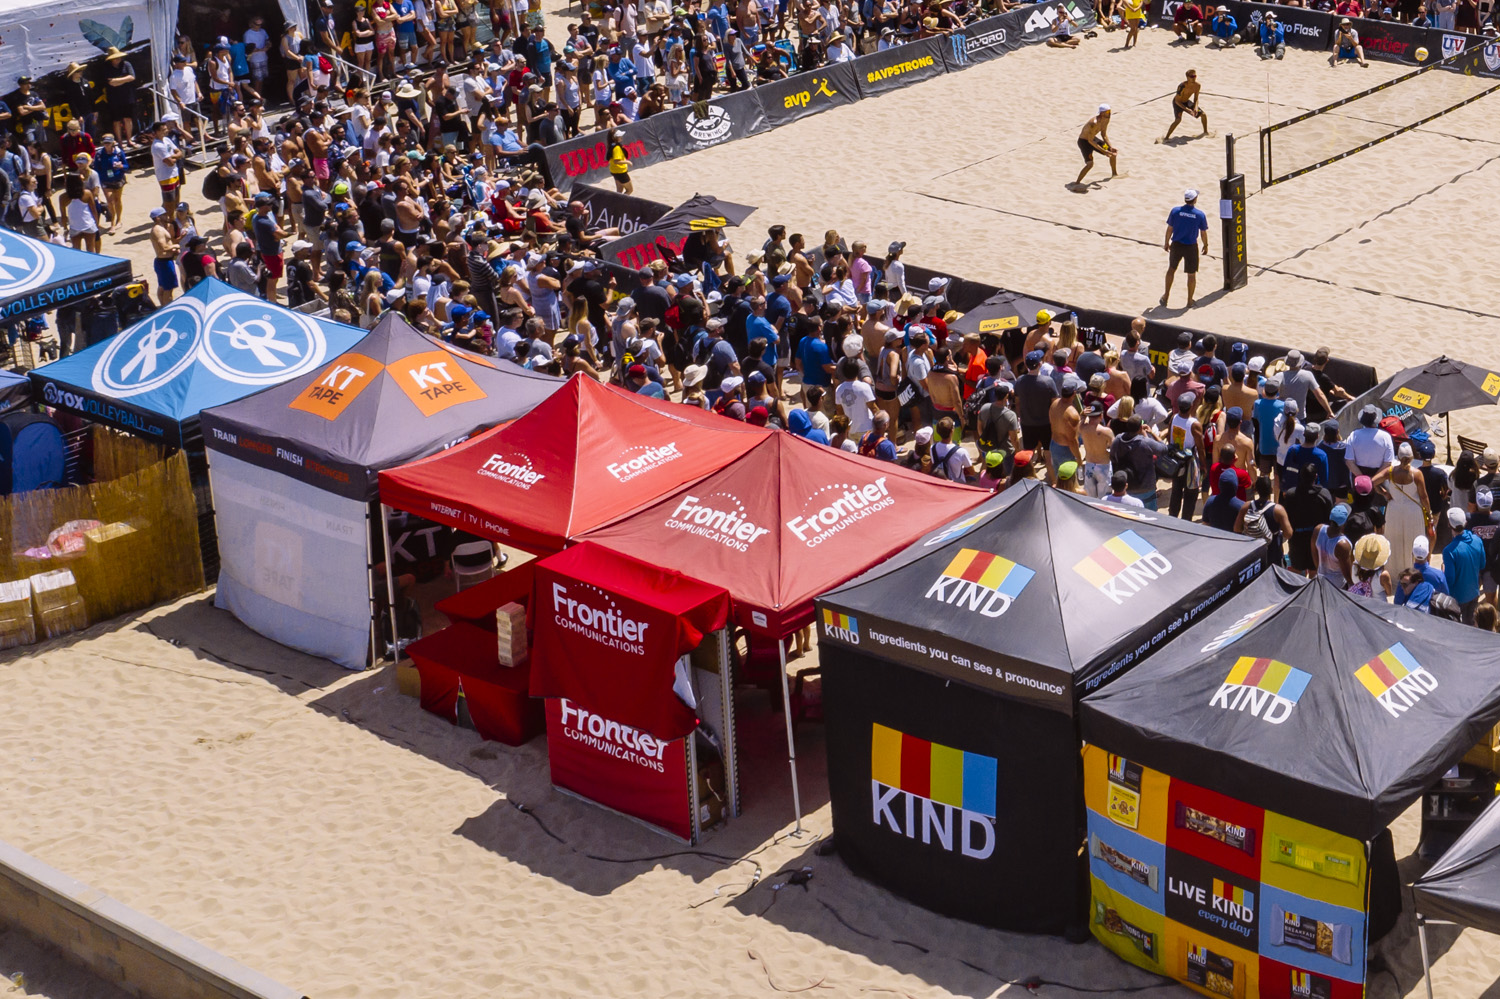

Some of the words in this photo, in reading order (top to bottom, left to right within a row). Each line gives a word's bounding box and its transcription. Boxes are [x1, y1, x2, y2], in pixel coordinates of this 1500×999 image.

[967, 30, 1003, 48] HYDRO
[1293, 23, 1320, 37] Flask
[1443, 37, 1464, 52] UV
[866, 55, 934, 84] #AVPSTRONG
[784, 89, 810, 109] avp
[321, 365, 366, 391] KT
[409, 362, 458, 389] KT
[420, 381, 467, 402] TAPE
[308, 387, 344, 406] TAPE
[213, 428, 237, 445] TRAIN
[276, 448, 303, 467] FINISH
[606, 441, 679, 479] Frontier
[477, 468, 531, 490] COMMUNICATIONS
[483, 454, 545, 485] Frontier
[619, 451, 683, 483] COMMUNICATIONS
[430, 502, 461, 519] INTERNET
[468, 513, 478, 524] TV
[484, 520, 510, 537] PHONE
[672, 494, 771, 544] Frontier
[786, 476, 889, 542] Frontier
[806, 496, 895, 548] COMMUNICATIONS
[390, 526, 443, 565] KT
[665, 518, 749, 553] COMMUNICATIONS
[1098, 552, 1173, 605] KIND
[552, 582, 649, 643] Frontier
[924, 575, 1014, 618] KIND
[554, 614, 645, 656] COMMUNICATIONS
[824, 623, 860, 645] KIND
[1085, 651, 1134, 690] ingredients
[1135, 641, 1150, 659] you
[1151, 629, 1167, 645] can
[1167, 618, 1182, 634] see
[1183, 612, 1190, 622] &
[869, 628, 927, 654] ingredients
[929, 647, 949, 661] you
[951, 654, 971, 669] can
[974, 661, 993, 676] see
[995, 668, 1003, 679] &
[1209, 683, 1293, 724] KIND
[1376, 667, 1439, 719] KIND
[560, 697, 670, 761] Frontier
[564, 727, 665, 773] COMMUNICATIONS
[872, 779, 996, 860] KIND
[1225, 825, 1246, 838] KIND
[1131, 859, 1150, 875] KIND
[1168, 877, 1206, 905] LIVE
[1212, 894, 1253, 923] KIND
[1198, 909, 1229, 928] every
[1229, 922, 1251, 938] day
[1285, 917, 1300, 928] KIND
[1188, 952, 1206, 966] KIND
[1293, 983, 1310, 995] KIND
